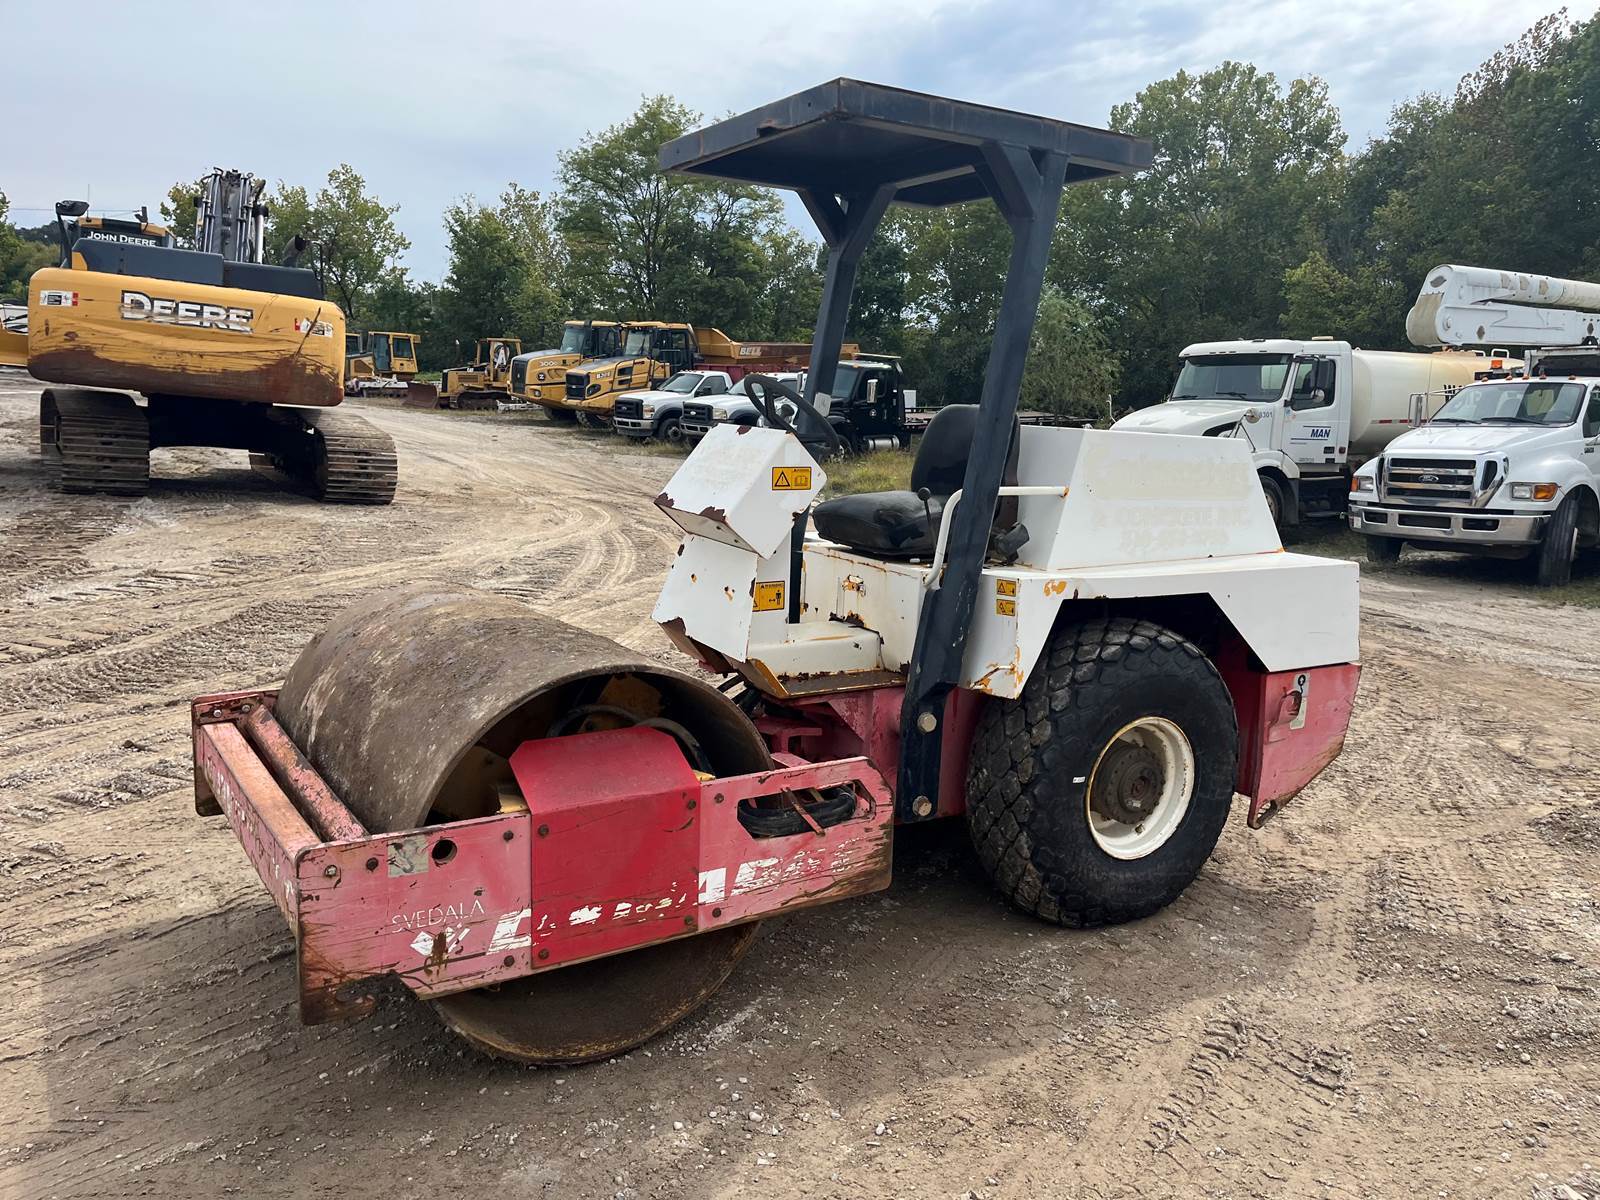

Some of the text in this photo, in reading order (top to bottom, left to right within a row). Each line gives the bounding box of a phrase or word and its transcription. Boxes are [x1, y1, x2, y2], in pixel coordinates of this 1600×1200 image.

[87, 231, 157, 247] JOHN DEERE
[120, 290, 254, 334] DEERE
[740, 346, 761, 357] BELL
[1311, 429, 1331, 438] MAN
[391, 899, 485, 934] SVEDALA
